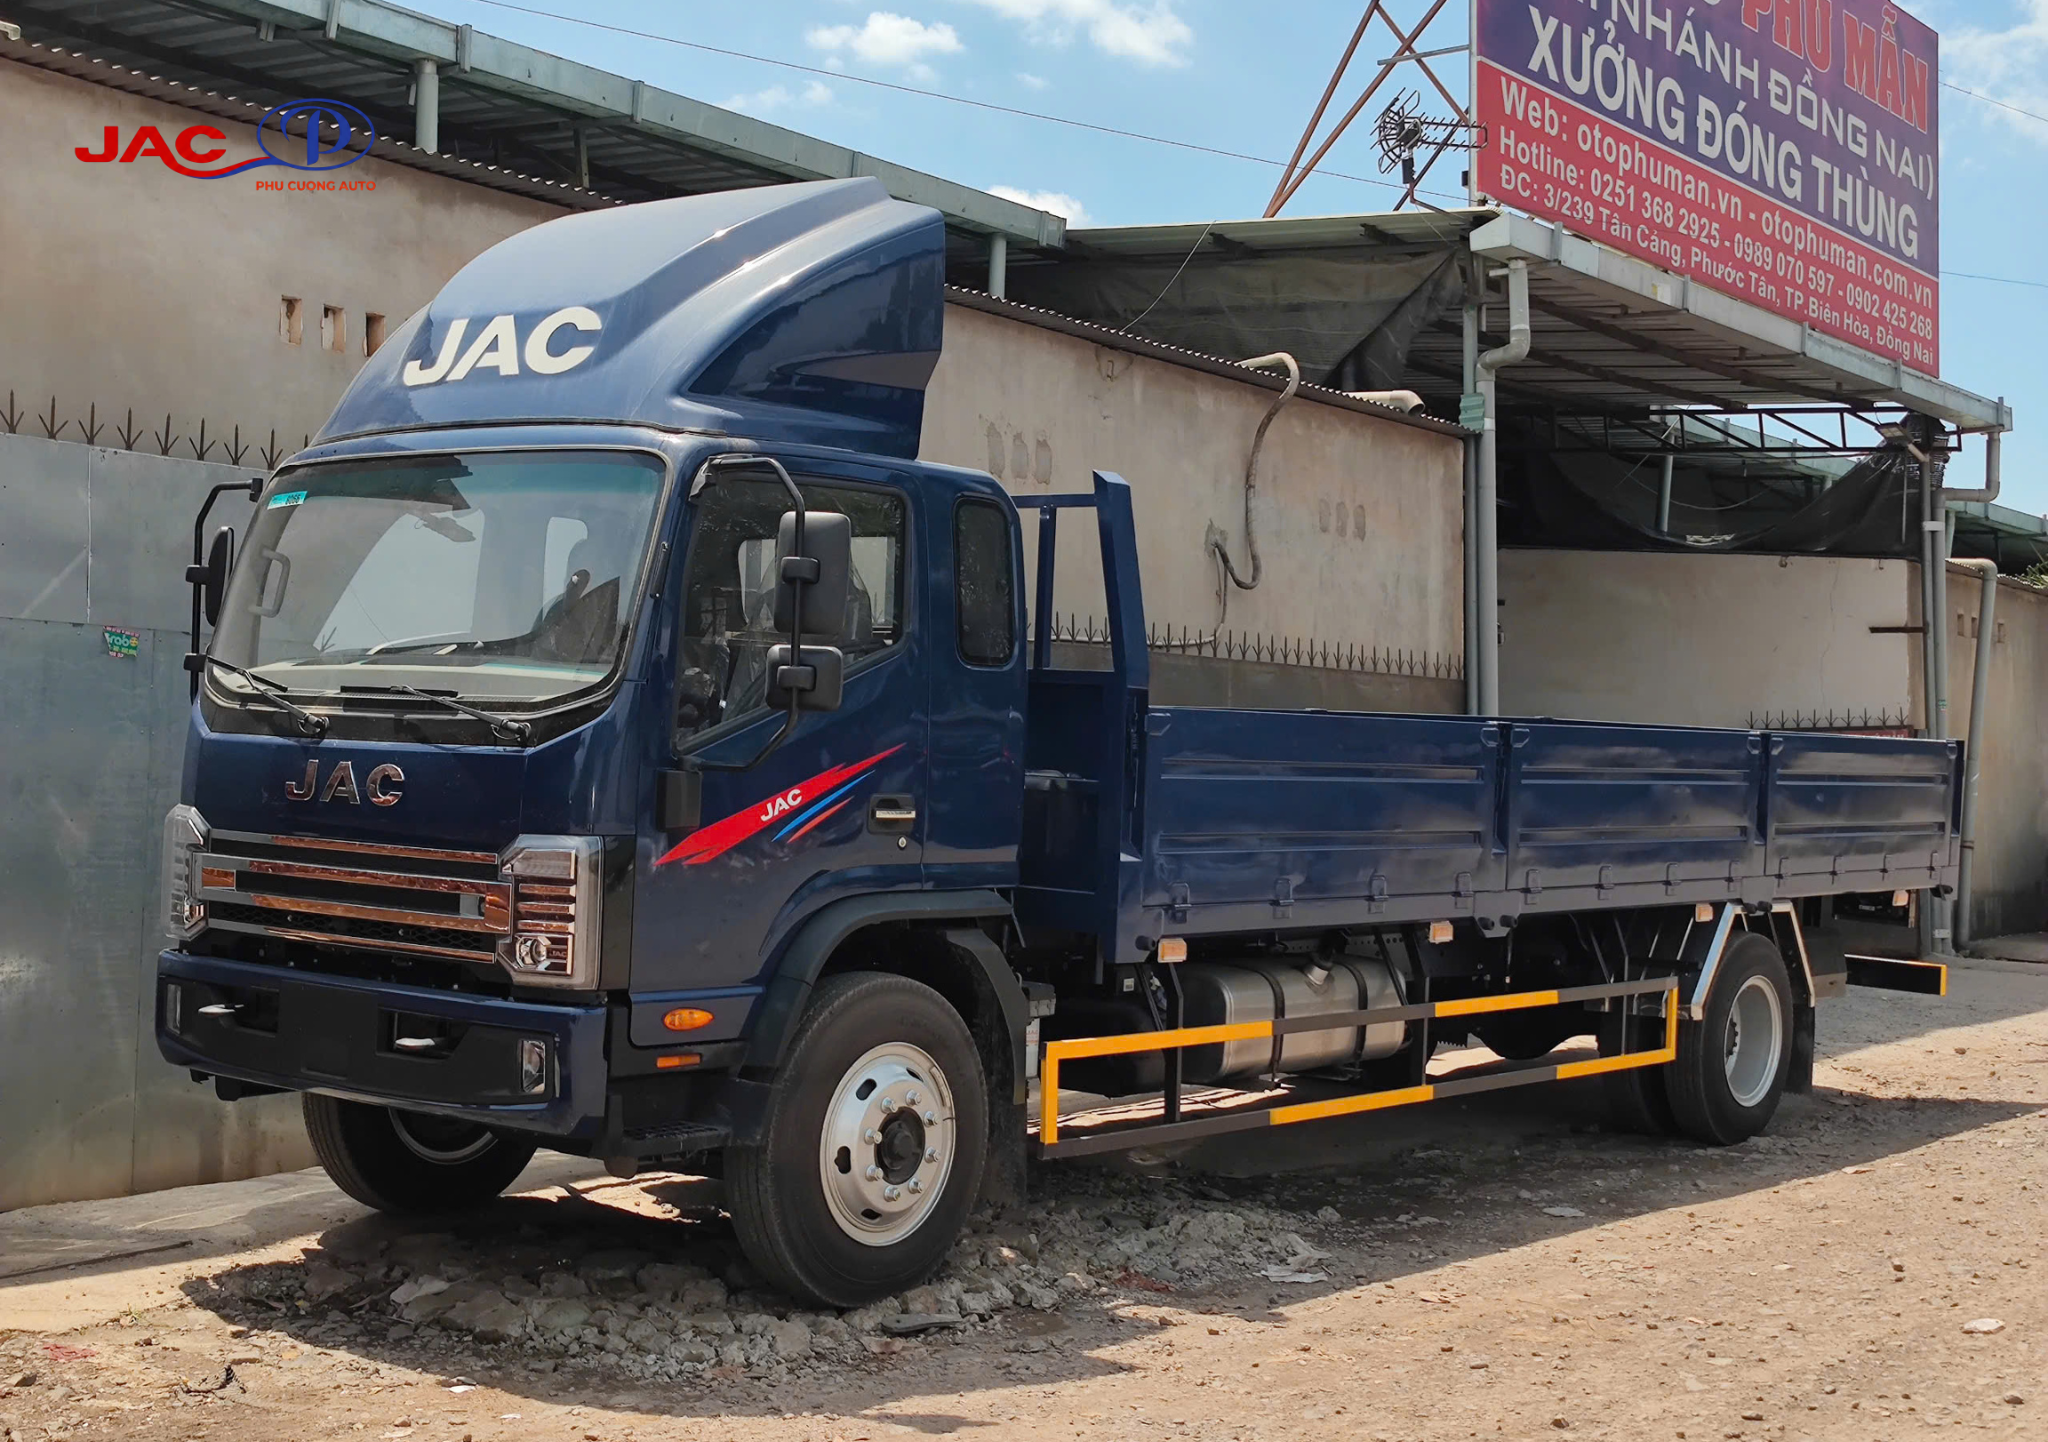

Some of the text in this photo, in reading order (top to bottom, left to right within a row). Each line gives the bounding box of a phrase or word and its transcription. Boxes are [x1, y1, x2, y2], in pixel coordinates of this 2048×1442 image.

[1527, 4, 1918, 259] XƯỞNG ĐÓNG THÙNG
[1768, 68, 1867, 157] ĐỒNG
[1876, 129, 1933, 200] NAI)
[1843, 5, 1927, 134] MẪN
[1500, 76, 1567, 141] Web:
[1577, 123, 1741, 222] otophuman.vn
[1762, 210, 1932, 309] otophuman.com.vn
[1500, 125, 1584, 190] Hotline:
[1591, 168, 1635, 212] 0251
[1641, 191, 1673, 228] 368
[1678, 208, 1719, 248] 2925
[1734, 233, 1772, 271] 0989
[1777, 252, 1803, 284] 070
[1808, 266, 1834, 296] 597
[1846, 283, 1880, 318] 0902
[1883, 300, 1907, 329] 425
[1910, 312, 1933, 340] 268
[1500, 163, 1538, 202] ĐC:
[1544, 183, 1594, 225] 3/239
[1599, 206, 1632, 241] Tân
[1637, 223, 1686, 267] Cảng,
[1691, 247, 1744, 288] Phước
[1749, 271, 1780, 306] Tân,
[1844, 311, 1873, 344] Hòa,
[1876, 325, 1911, 360] Đồng
[1914, 341, 1933, 365] Nai
[403, 306, 602, 387] JAC
[285, 759, 405, 806] JAC
[760, 789, 802, 822] JAC
